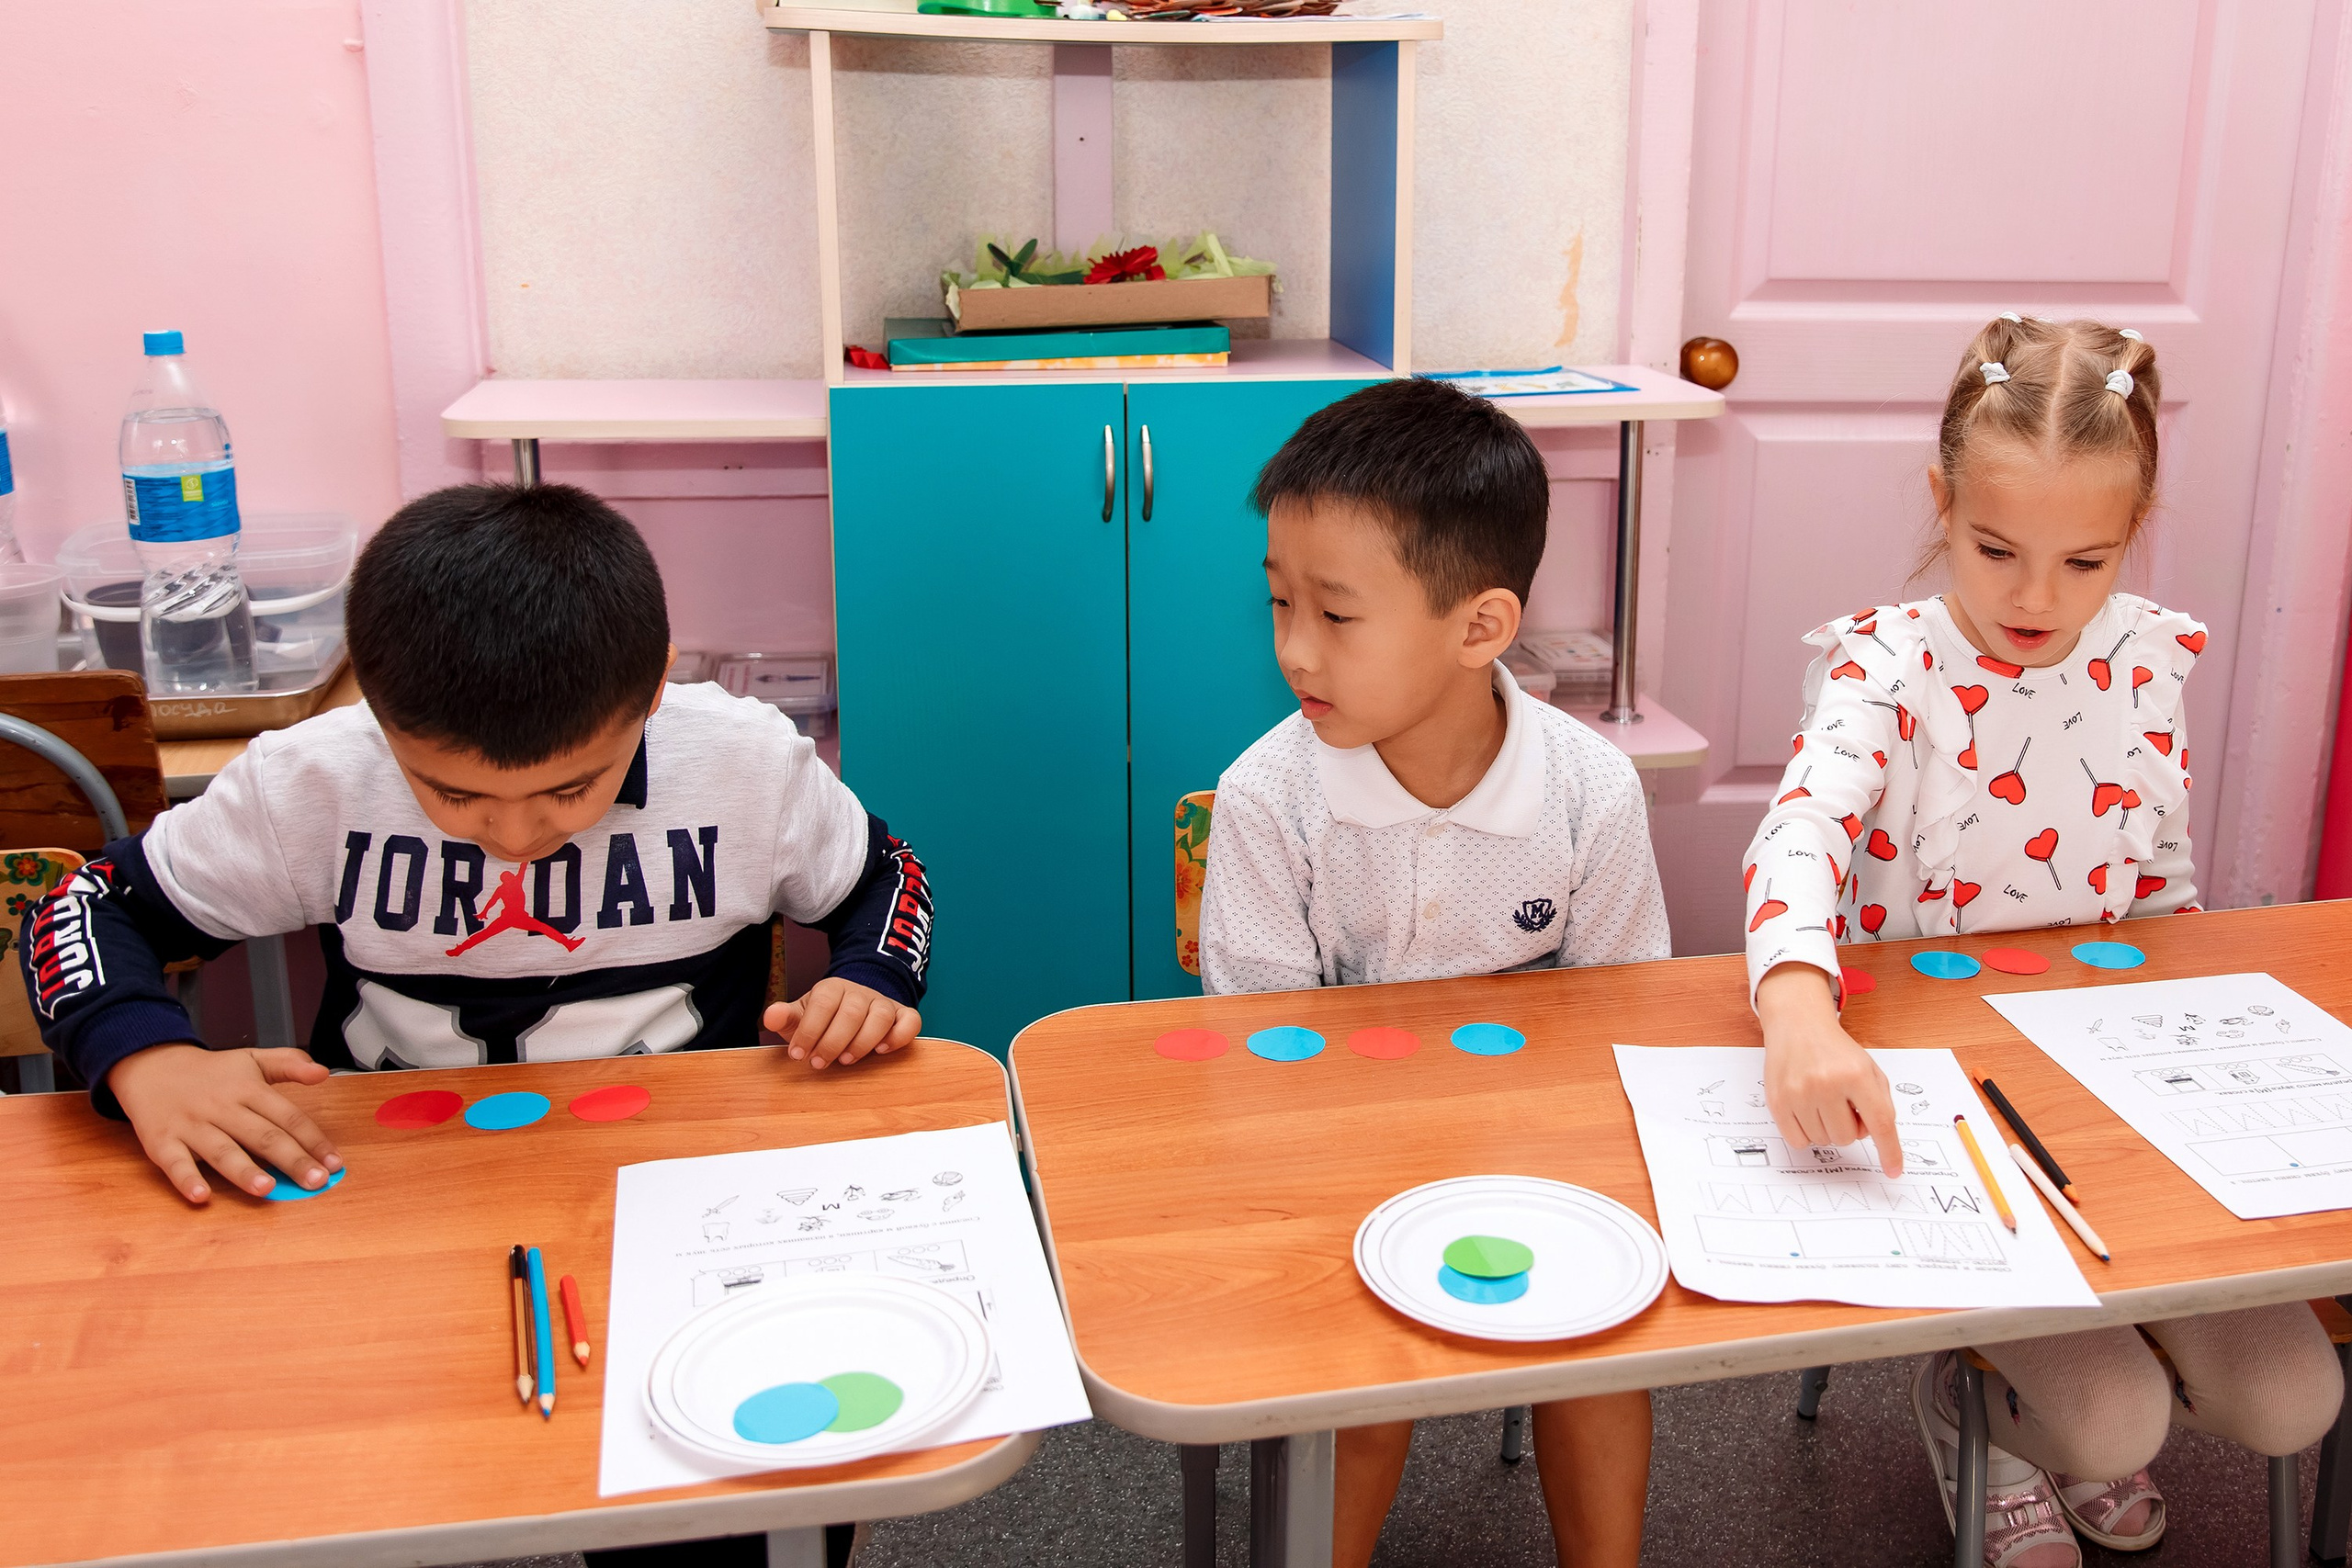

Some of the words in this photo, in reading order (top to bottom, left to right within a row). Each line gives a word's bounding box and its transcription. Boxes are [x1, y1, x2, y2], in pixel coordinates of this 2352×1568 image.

[1889, 679, 1905, 695] LOV
[2011, 682, 2036, 699] LOVE
[1821, 719, 1846, 731] OVE
[2062, 711, 2083, 730] LOVE
[1834, 746, 1860, 761] LOVE
[1957, 813, 1980, 831] LOVE
[1765, 821, 1791, 841] LOVE
[1913, 834, 1926, 853] LOV
[2156, 840, 2178, 852] LOVE
[1788, 849, 1817, 862] LOVE
[334, 826, 718, 937] JORDAN
[2003, 884, 2029, 903] LOVE
[1531, 903, 1545, 919] M
[1763, 946, 1791, 968] LOVE
